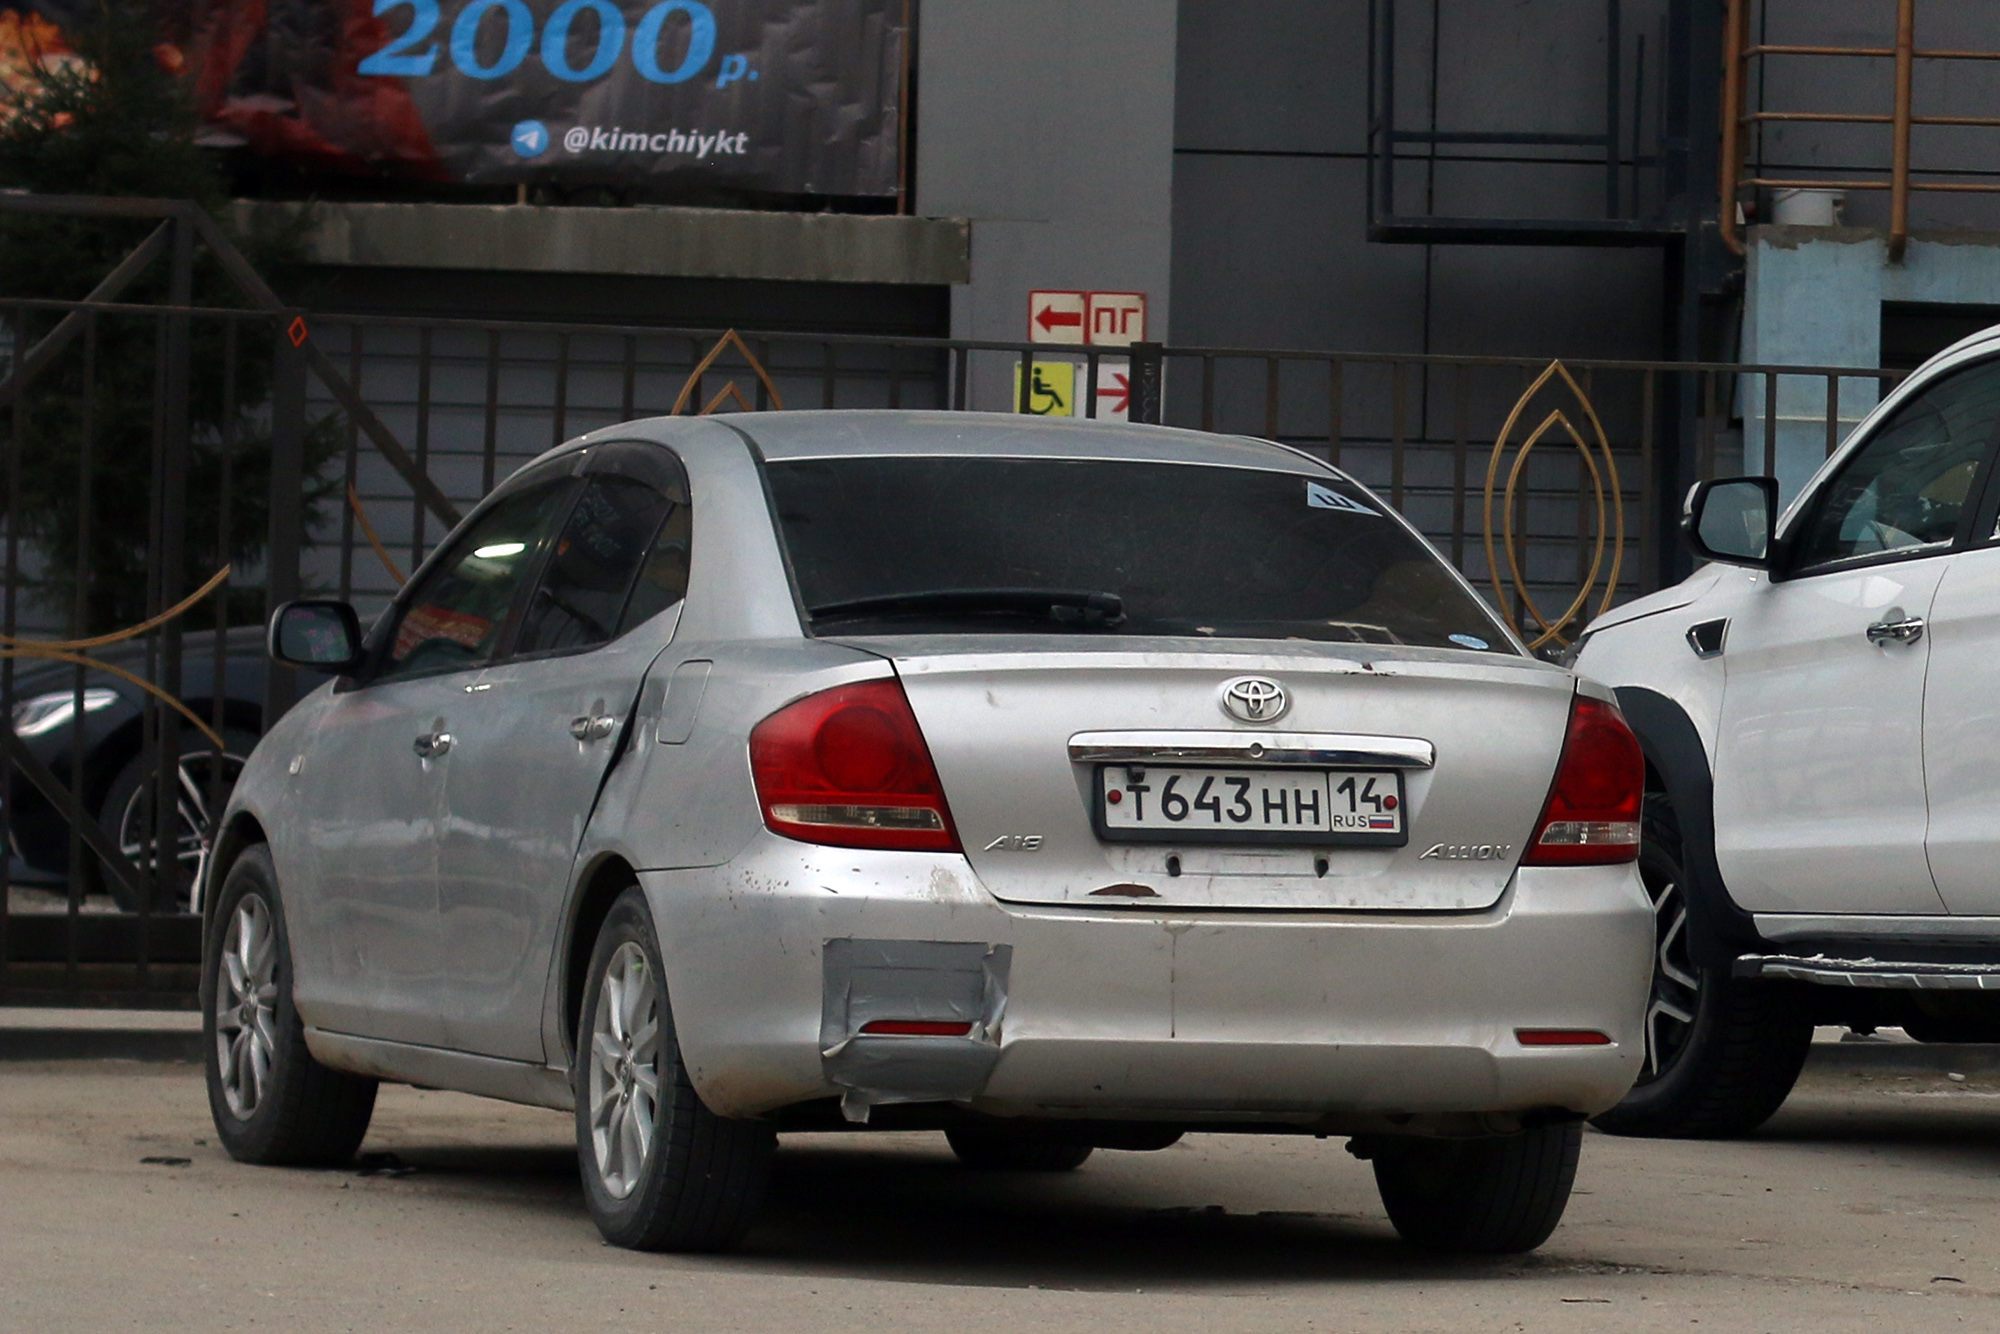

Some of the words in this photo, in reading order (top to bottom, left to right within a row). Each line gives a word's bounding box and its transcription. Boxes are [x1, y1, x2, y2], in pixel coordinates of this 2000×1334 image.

[357, 0, 717, 84] 2000
[564, 126, 749, 159] @kimchiykt
[1094, 307, 1139, 334] ПГ
[1336, 777, 1382, 813] 14
[1333, 815, 1368, 828] RUS
[1419, 843, 1511, 860] ALLION
